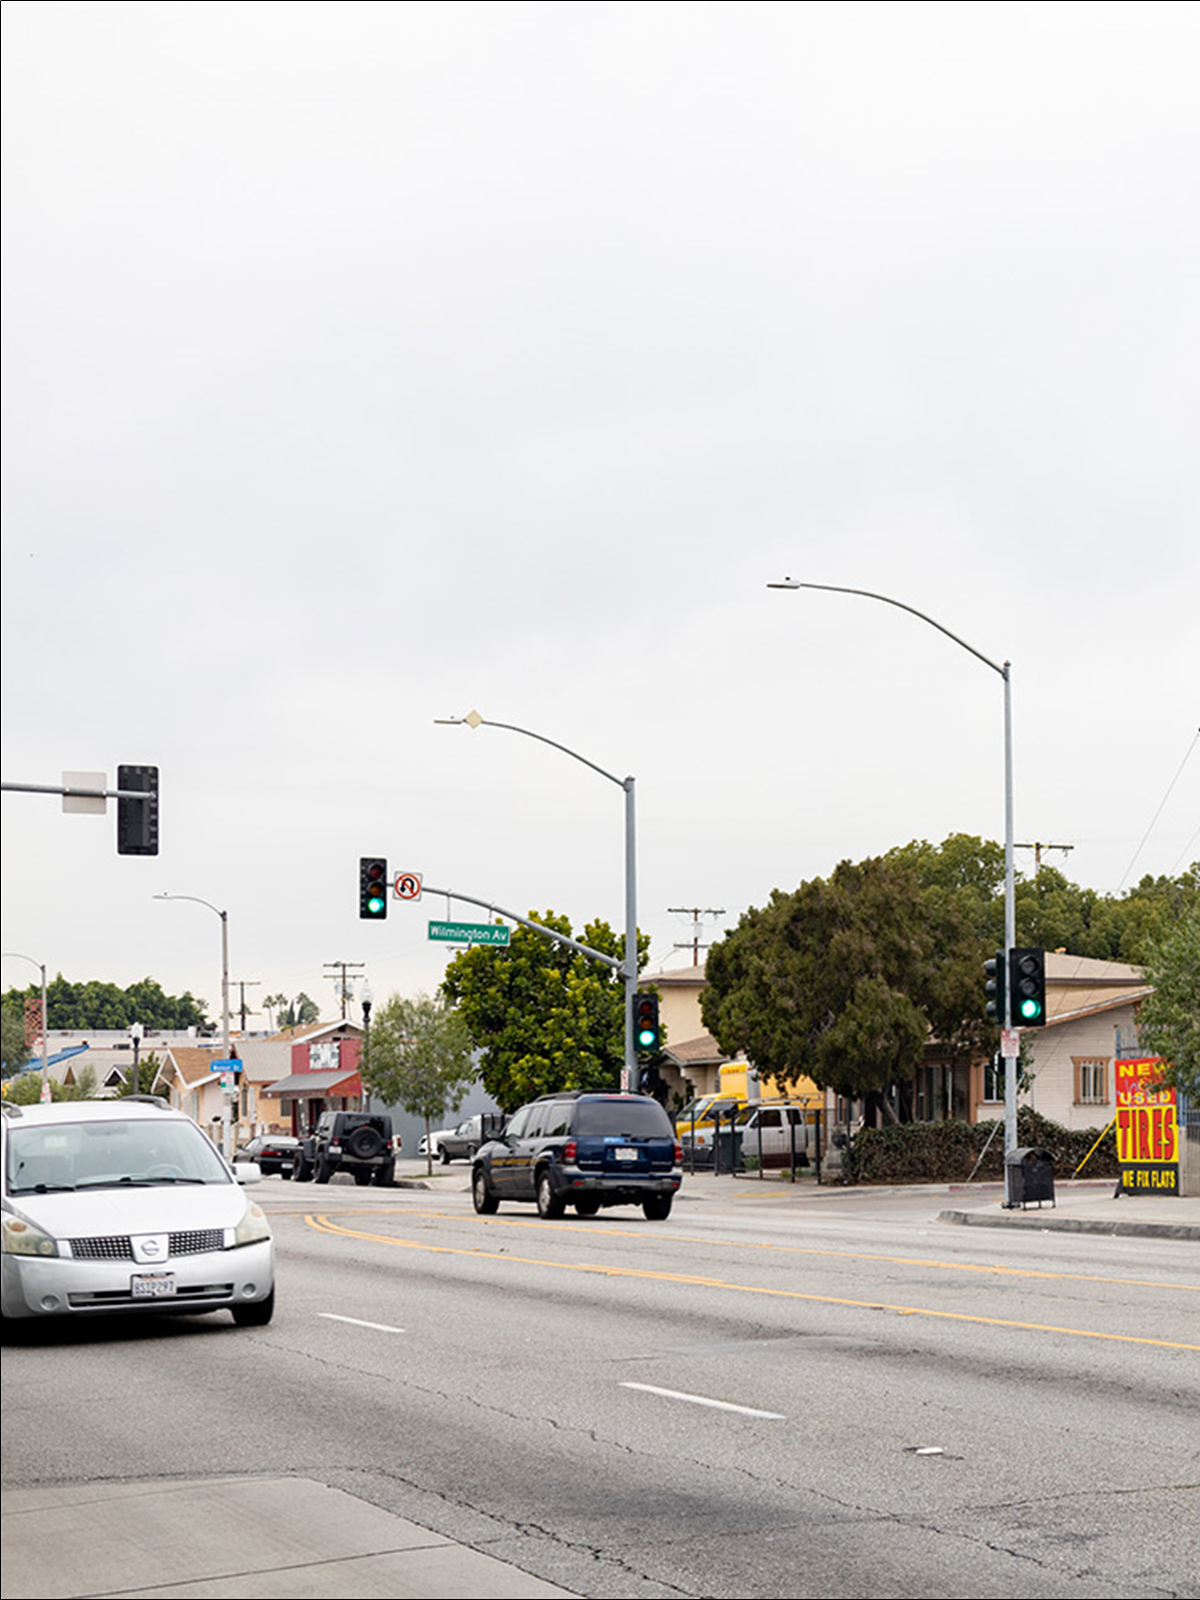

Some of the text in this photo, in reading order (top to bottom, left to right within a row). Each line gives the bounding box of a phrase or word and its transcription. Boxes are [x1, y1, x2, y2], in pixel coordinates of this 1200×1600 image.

[430, 925, 508, 942] Wilmington Av
[1119, 1090, 1171, 1105] USED
[1118, 1107, 1174, 1161] TIRES
[1122, 1169, 1176, 1189] WE FIX FLATS
